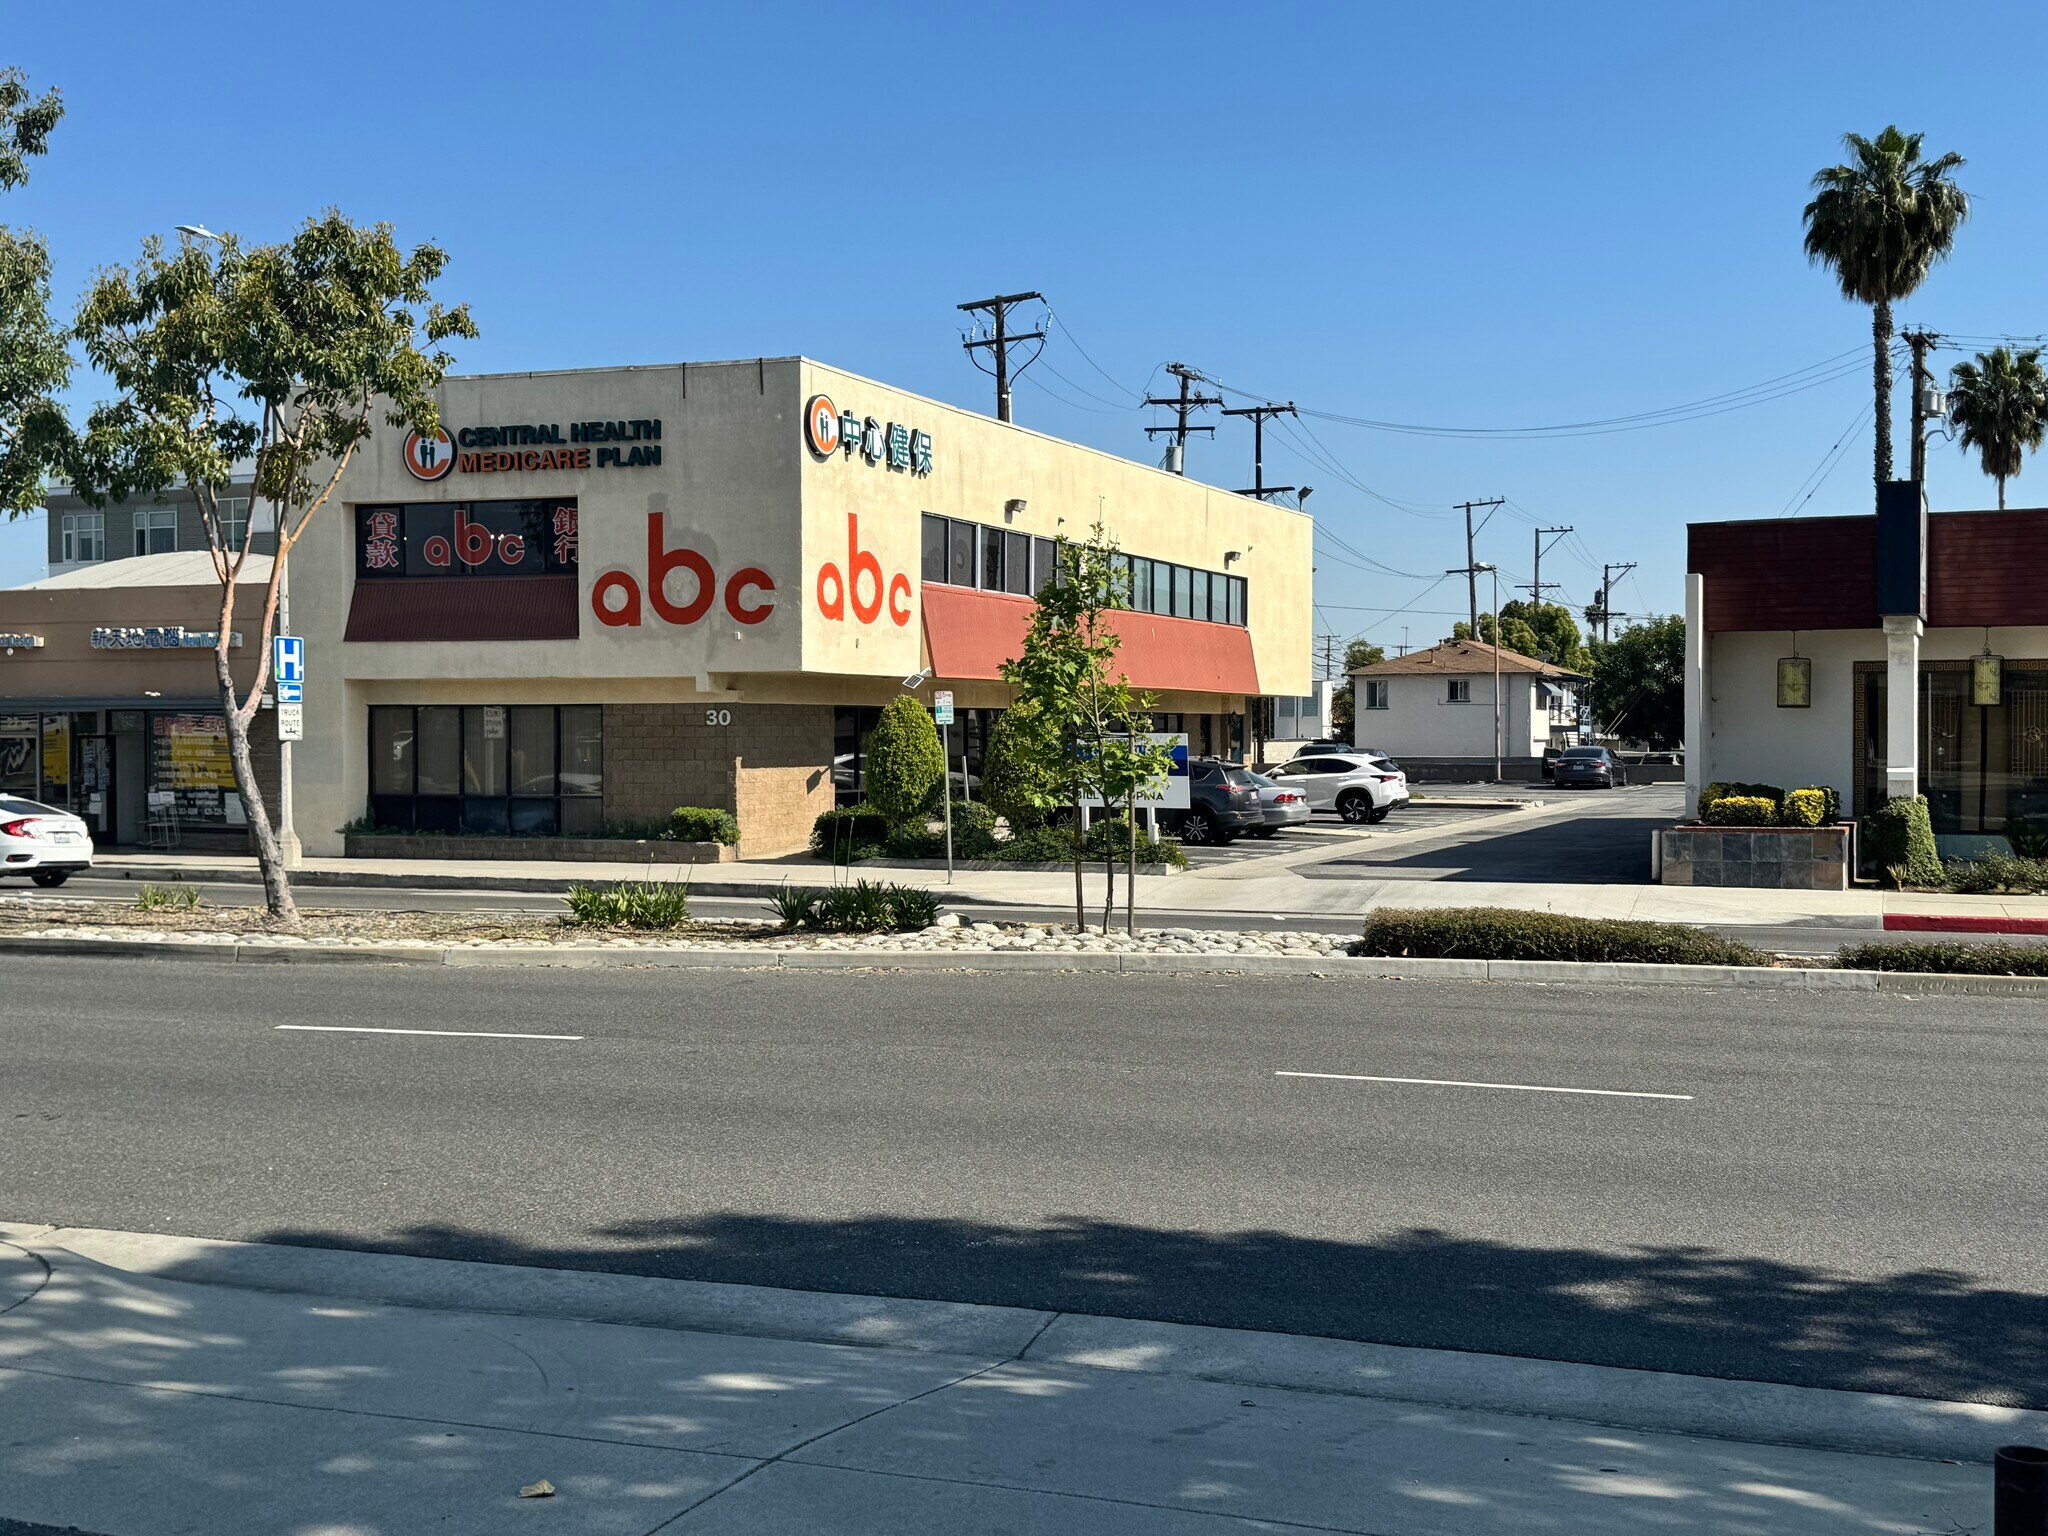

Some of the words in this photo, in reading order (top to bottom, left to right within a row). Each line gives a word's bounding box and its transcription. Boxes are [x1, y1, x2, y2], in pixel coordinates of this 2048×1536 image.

[458, 424, 567, 447] CENTRAL
[570, 419, 662, 443] HEALTH
[838, 409, 933, 473] 中心健保
[459, 448, 590, 473] MEDICARE
[597, 445, 662, 468] PLAN
[366, 512, 399, 568] 貸款
[423, 510, 525, 566] abc
[592, 511, 776, 626] abc
[817, 512, 912, 627] abc
[279, 639, 300, 680] H
[281, 719, 300, 727] ROUTE
[705, 709, 731, 726] 30
